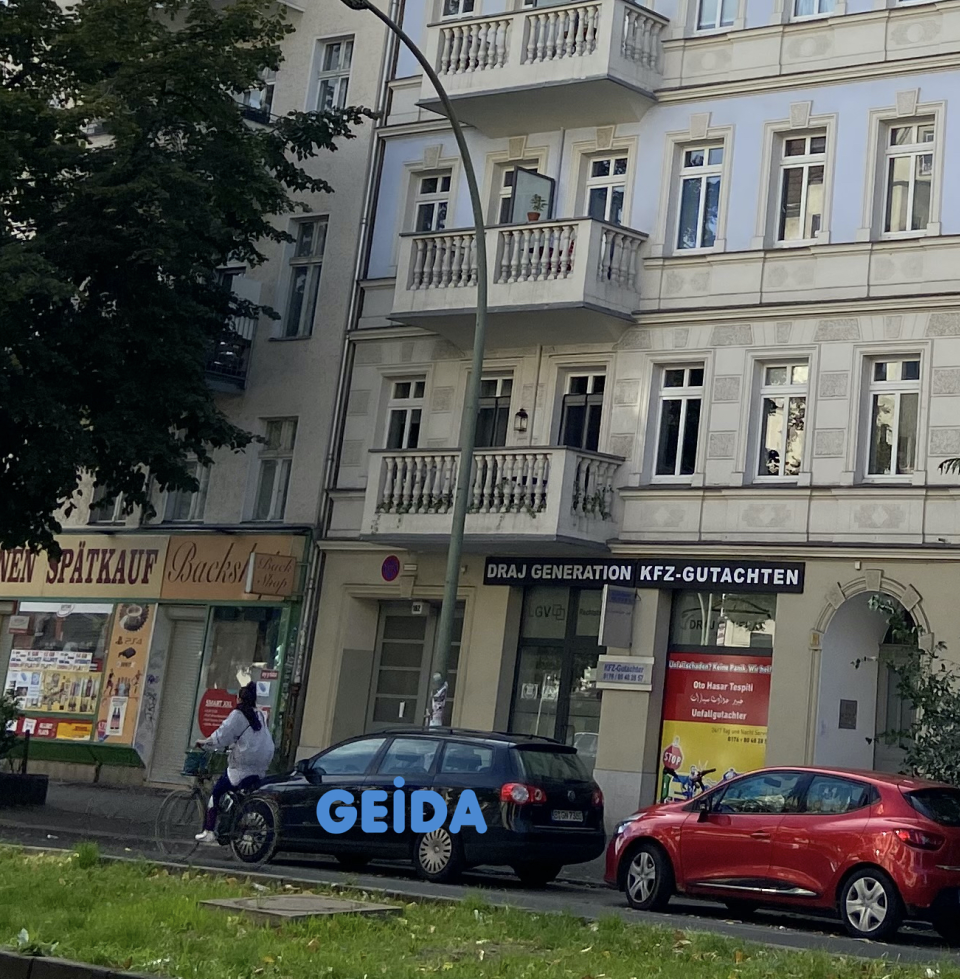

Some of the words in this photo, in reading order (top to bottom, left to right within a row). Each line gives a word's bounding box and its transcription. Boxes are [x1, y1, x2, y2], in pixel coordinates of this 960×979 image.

[46, 541, 159, 585] SPÄTKAUF
[487, 565, 526, 579] DRAJ
[531, 565, 631, 581] GENERATION
[640, 566, 799, 585] KFZ-GUTACHTEN
[693, 680, 706, 690] Oto
[707, 681, 728, 691] Hasar
[691, 708, 747, 720] Unfallgutachter
[664, 751, 681, 765] STOP
